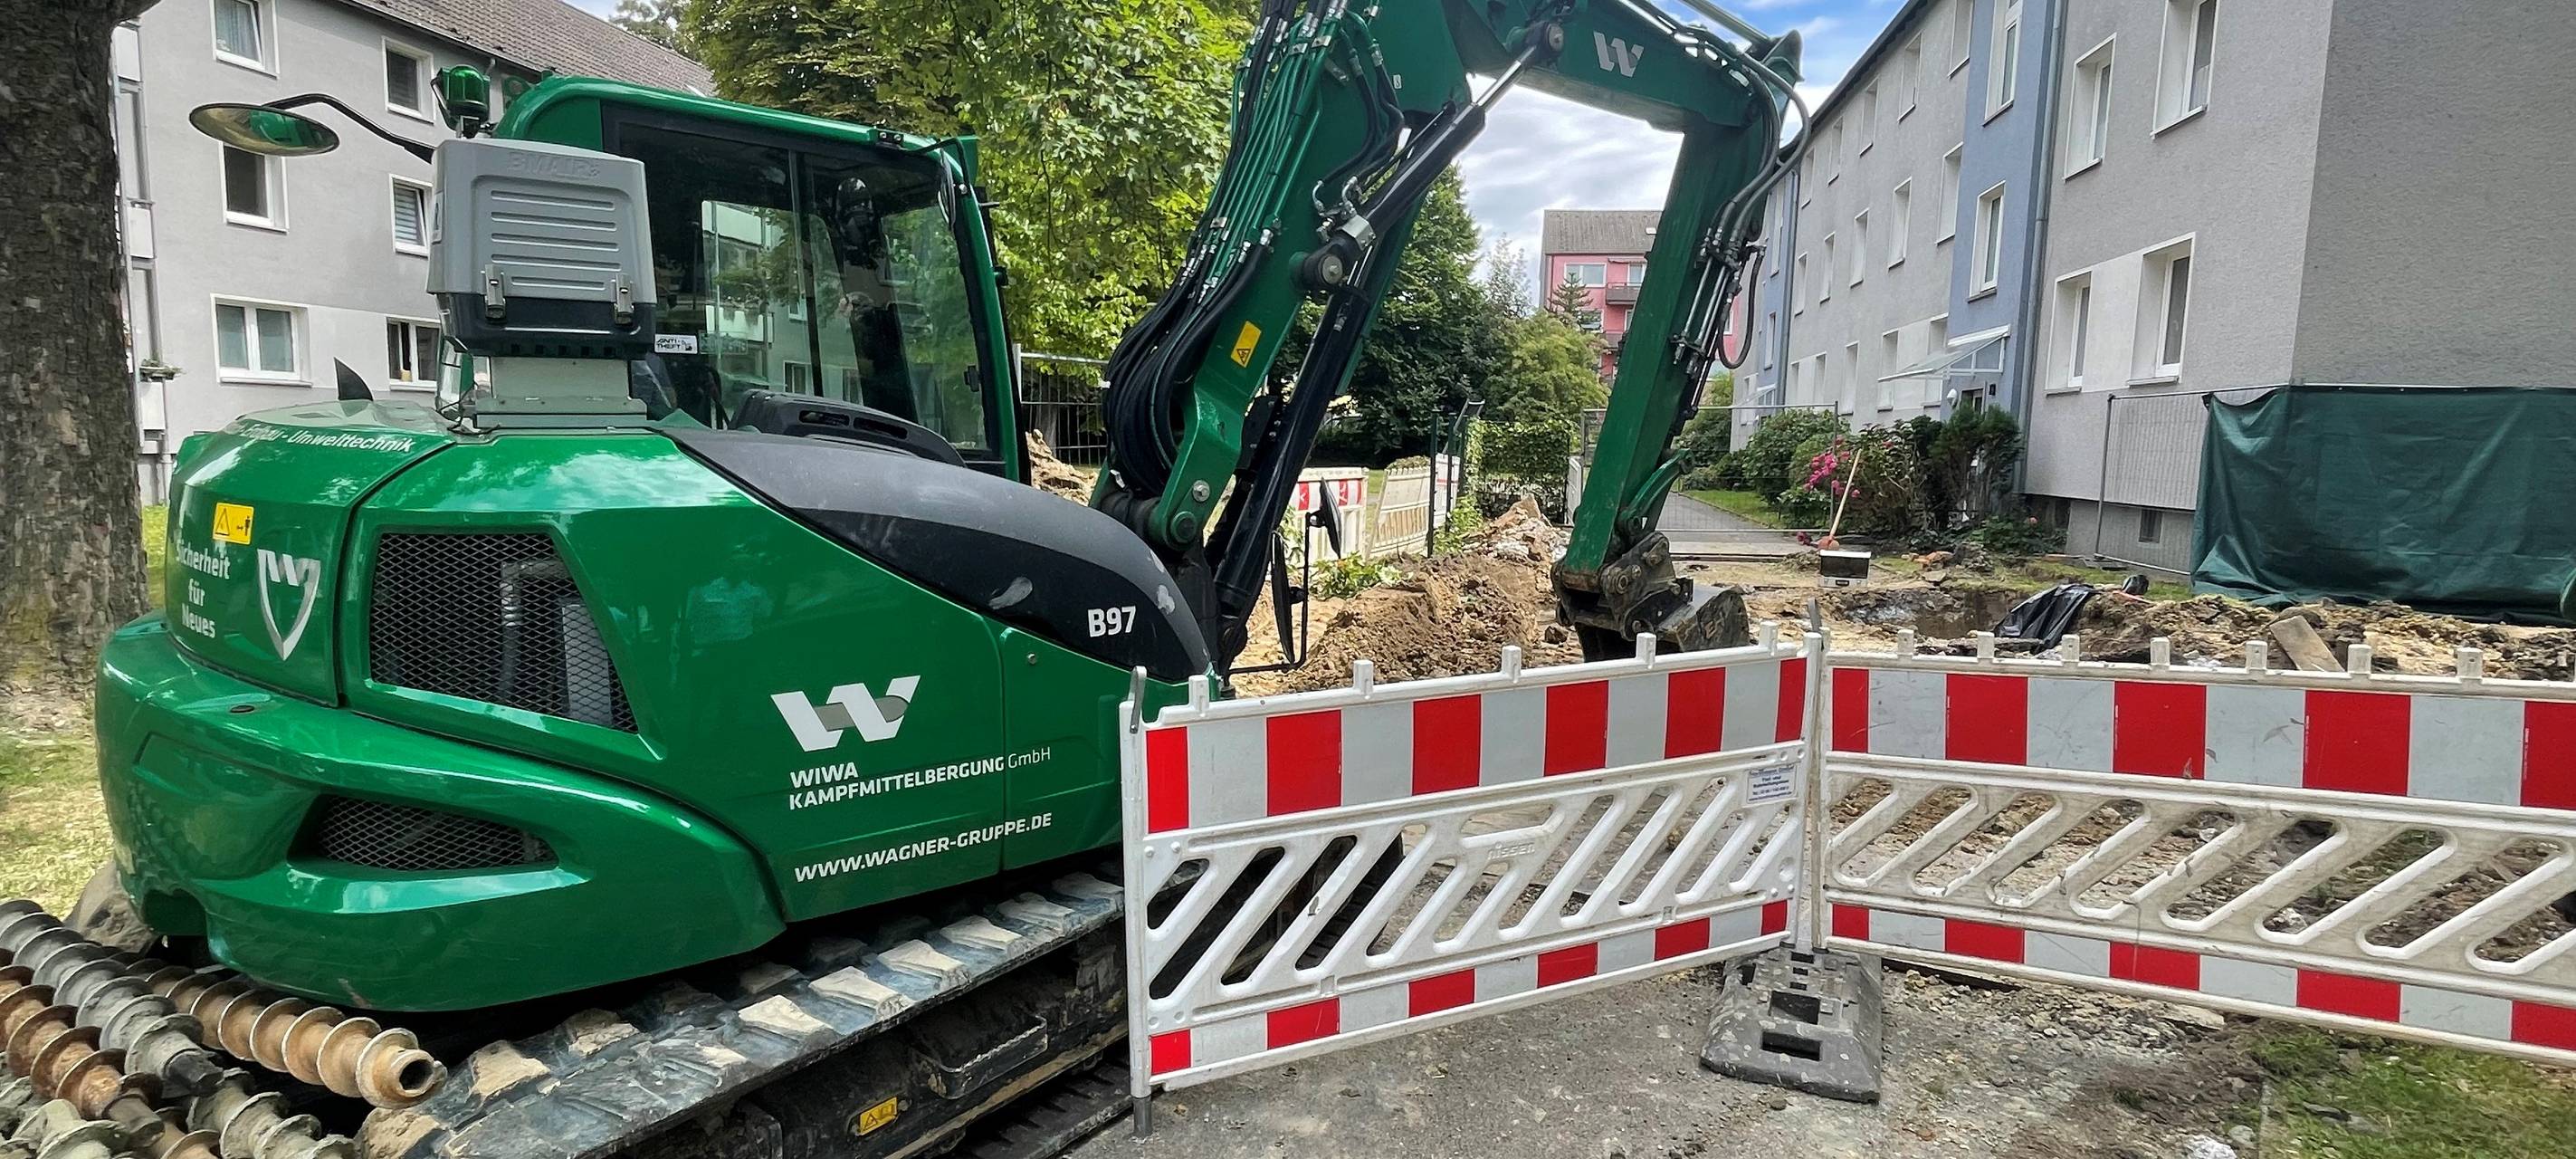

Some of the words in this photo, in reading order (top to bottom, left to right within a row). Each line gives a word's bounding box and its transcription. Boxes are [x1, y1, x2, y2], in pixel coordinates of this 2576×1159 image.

[287, 429, 416, 453] Umwelttechnik
[176, 540, 231, 580] Sicherheit
[188, 579, 205, 607] für
[182, 603, 215, 638] Neues
[1088, 606, 1136, 637] B97
[789, 762, 859, 789] WIWA
[789, 756, 1005, 810] KAMPFMITTELBERGUNG
[1007, 747, 1051, 769] GmbH
[795, 812, 1052, 882] WWW.WAGNER-GRUPPE.DE
